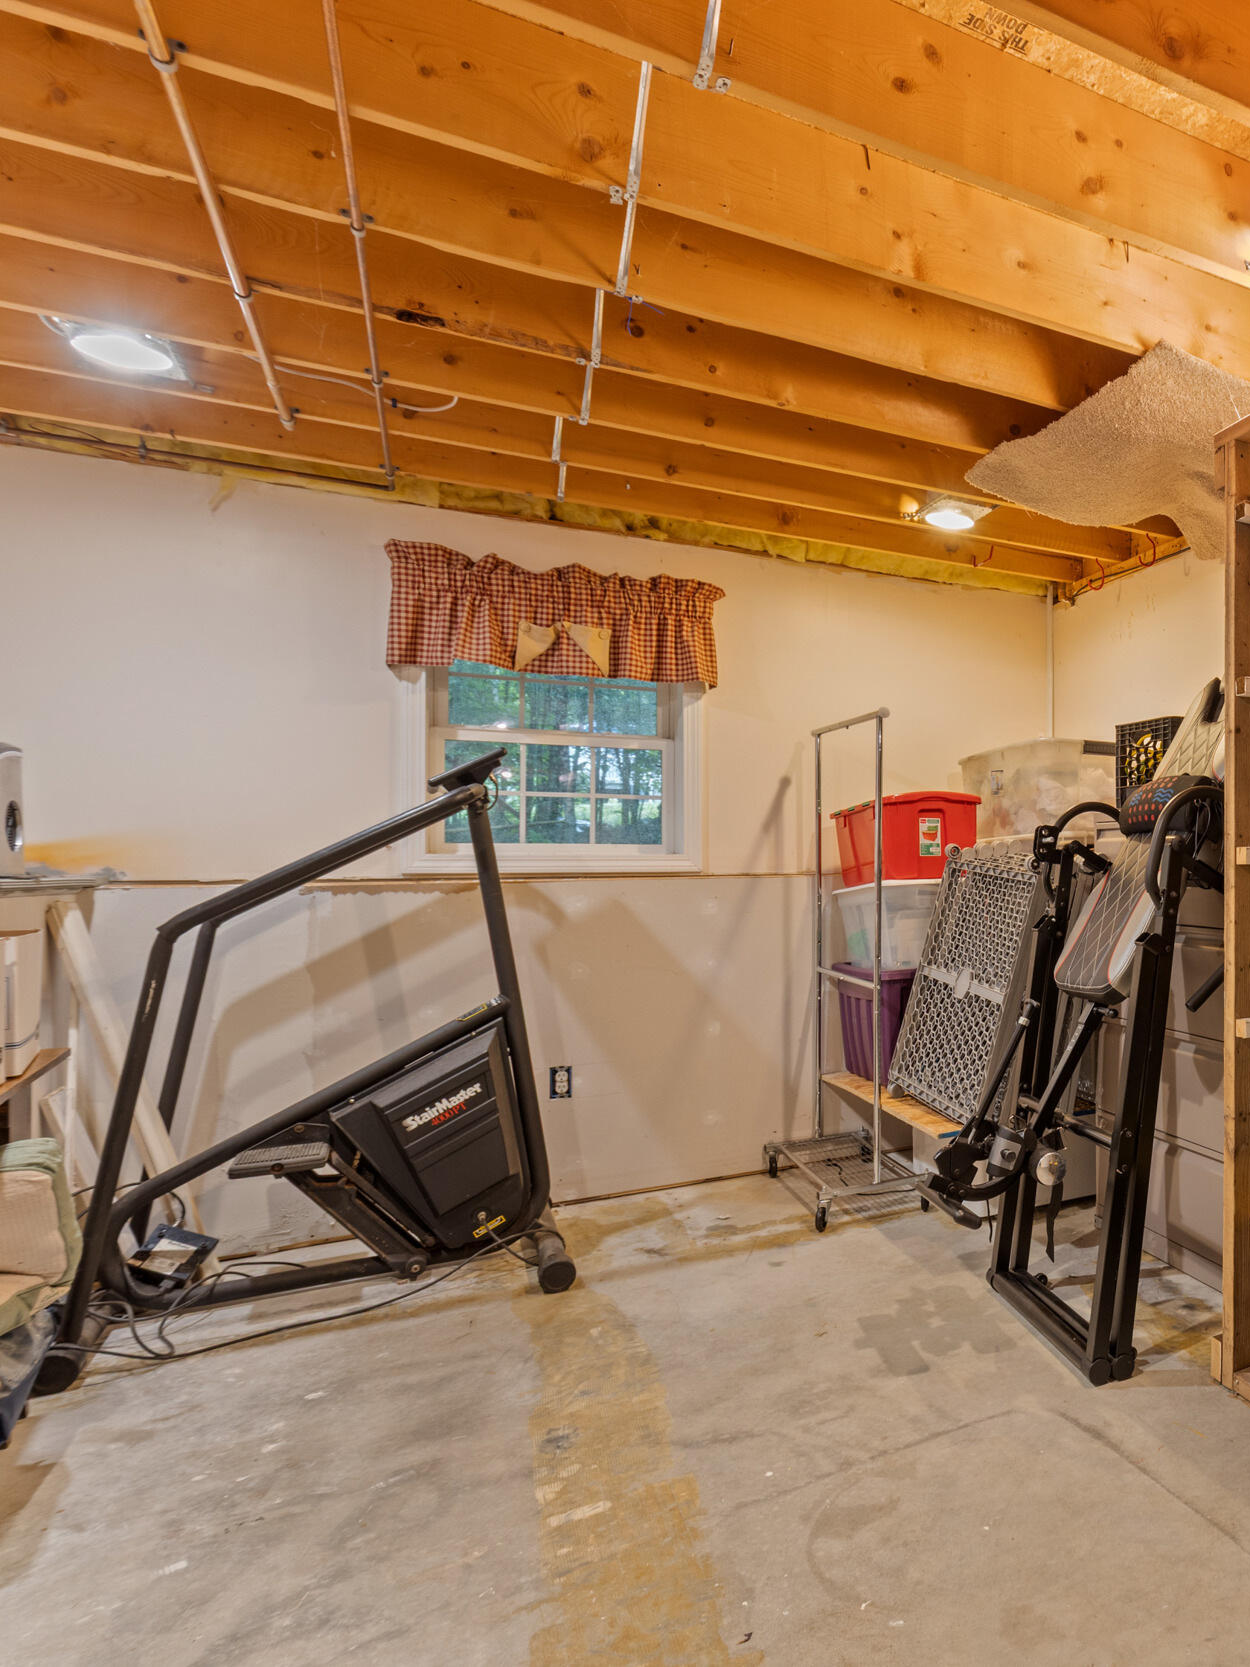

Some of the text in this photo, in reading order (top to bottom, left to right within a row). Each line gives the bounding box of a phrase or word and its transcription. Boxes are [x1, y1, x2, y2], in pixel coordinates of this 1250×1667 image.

[962, 13, 1029, 52] THIS SIDE
[984, 7, 1029, 36] DOWN
[401, 1082, 482, 1132] StairMaster
